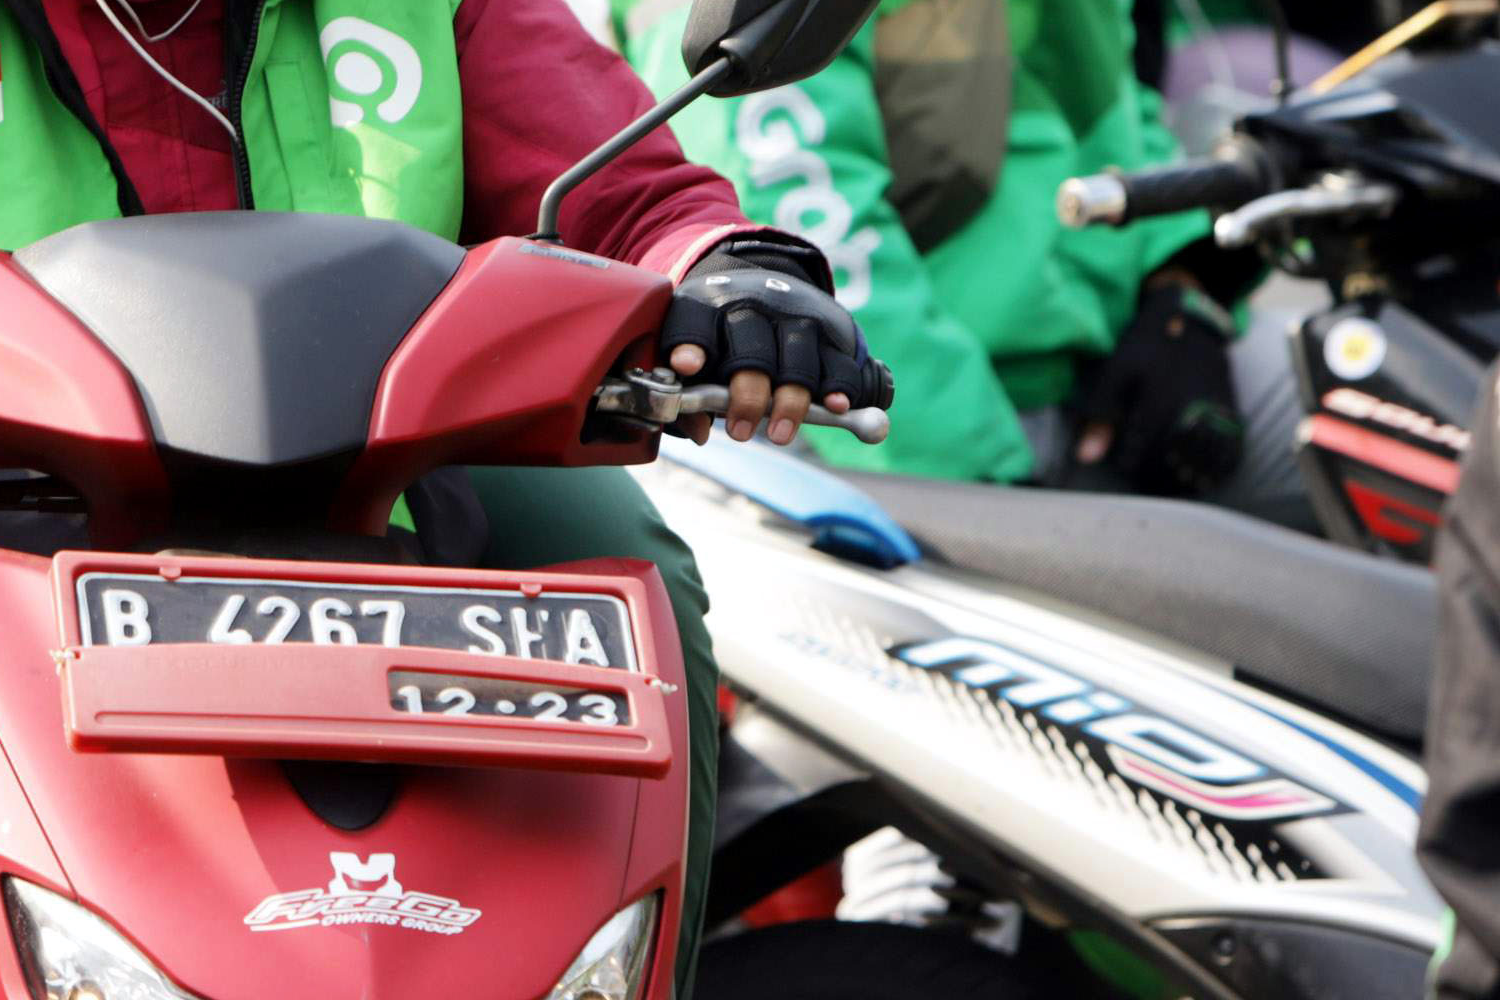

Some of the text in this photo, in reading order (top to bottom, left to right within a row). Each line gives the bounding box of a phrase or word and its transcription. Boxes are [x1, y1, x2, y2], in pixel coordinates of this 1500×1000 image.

[736, 84, 882, 312] Grab
[102, 589, 152, 647] B
[209, 594, 406, 648] 4267
[321, 912, 464, 936] OWNERS GROUP
